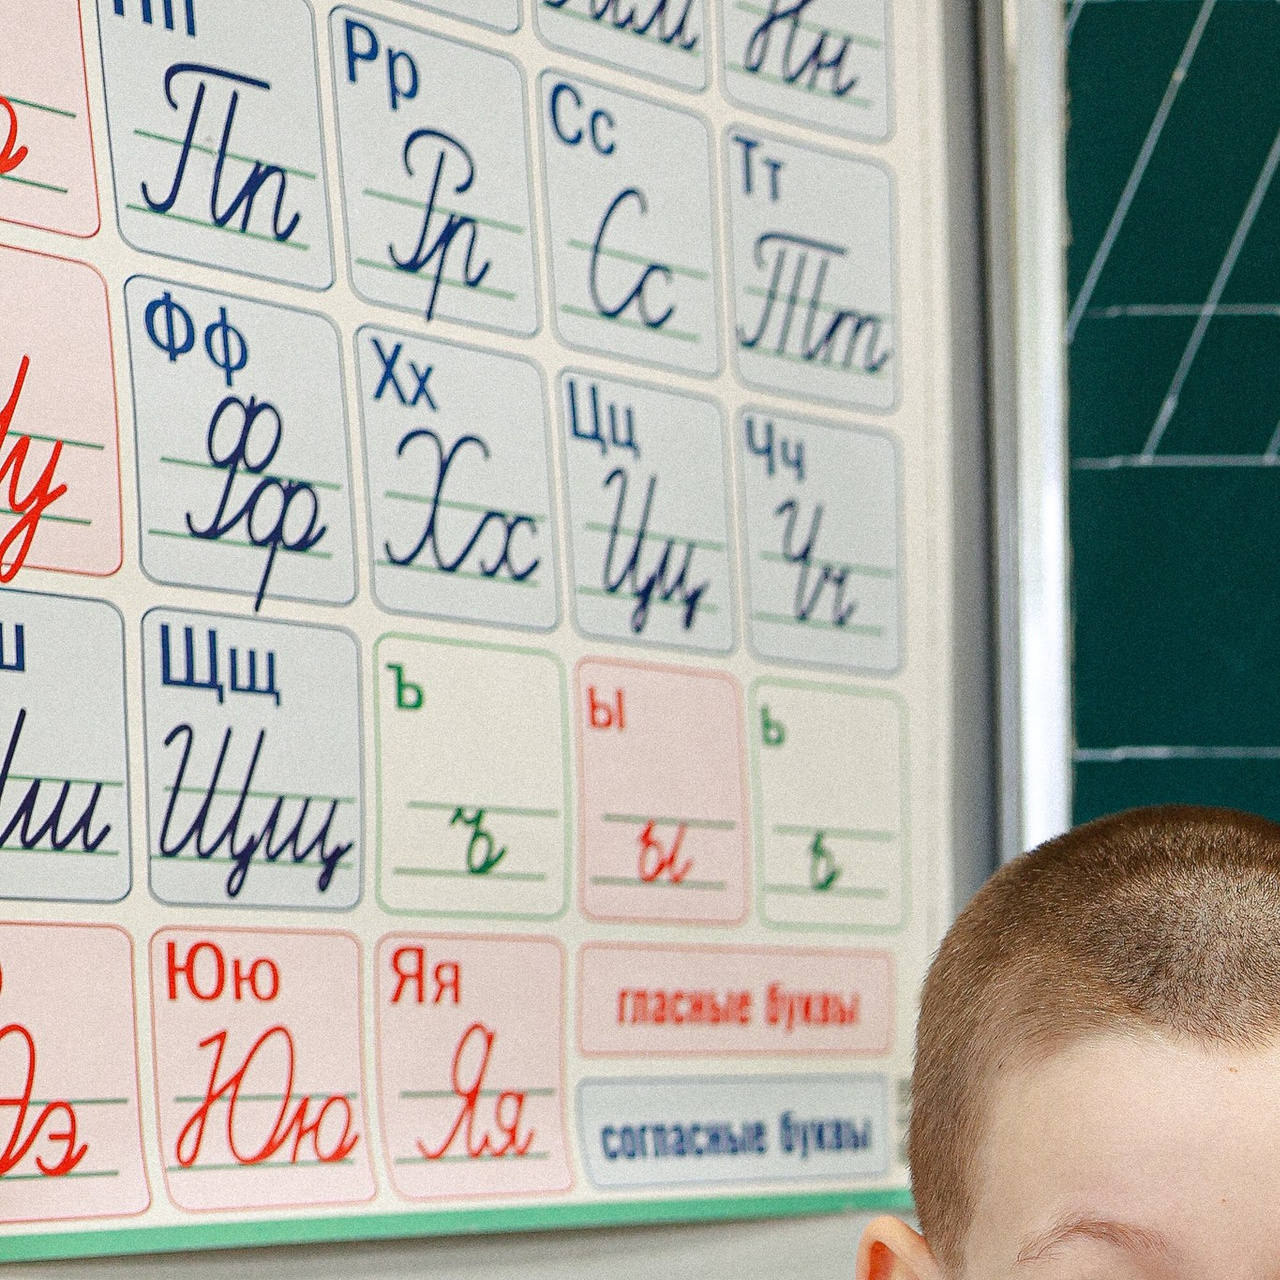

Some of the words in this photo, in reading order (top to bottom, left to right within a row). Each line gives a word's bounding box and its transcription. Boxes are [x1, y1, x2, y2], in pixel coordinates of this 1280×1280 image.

[345, 19, 419, 110] Рр
[142, 62, 300, 242] Пп
[551, 83, 616, 155] Сс
[733, 134, 783, 201] Тт
[389, 129, 491, 322] Рр
[589, 187, 675, 329] Сс
[145, 291, 249, 387] Фф
[736, 231, 889, 373] Тт
[372, 338, 437, 411] Хх
[567, 380, 641, 459] Цц
[744, 418, 805, 481] Чч
[186, 395, 326, 612] Фф
[385, 428, 540, 581] Хх
[604, 467, 709, 633] Цц
[775, 499, 858, 627] Чч
[159, 624, 281, 706] Щщ
[159, 723, 354, 898] Щщ
[167, 941, 281, 1002] Юю
[391, 946, 461, 1006] Яя
[616, 985, 752, 1026] гласные
[765, 981, 860, 1034] буквы
[176, 1025, 359, 1170] Юю
[416, 1023, 535, 1161] Яя
[600, 1119, 766, 1163] согласные
[780, 1110, 872, 1160] буквы
